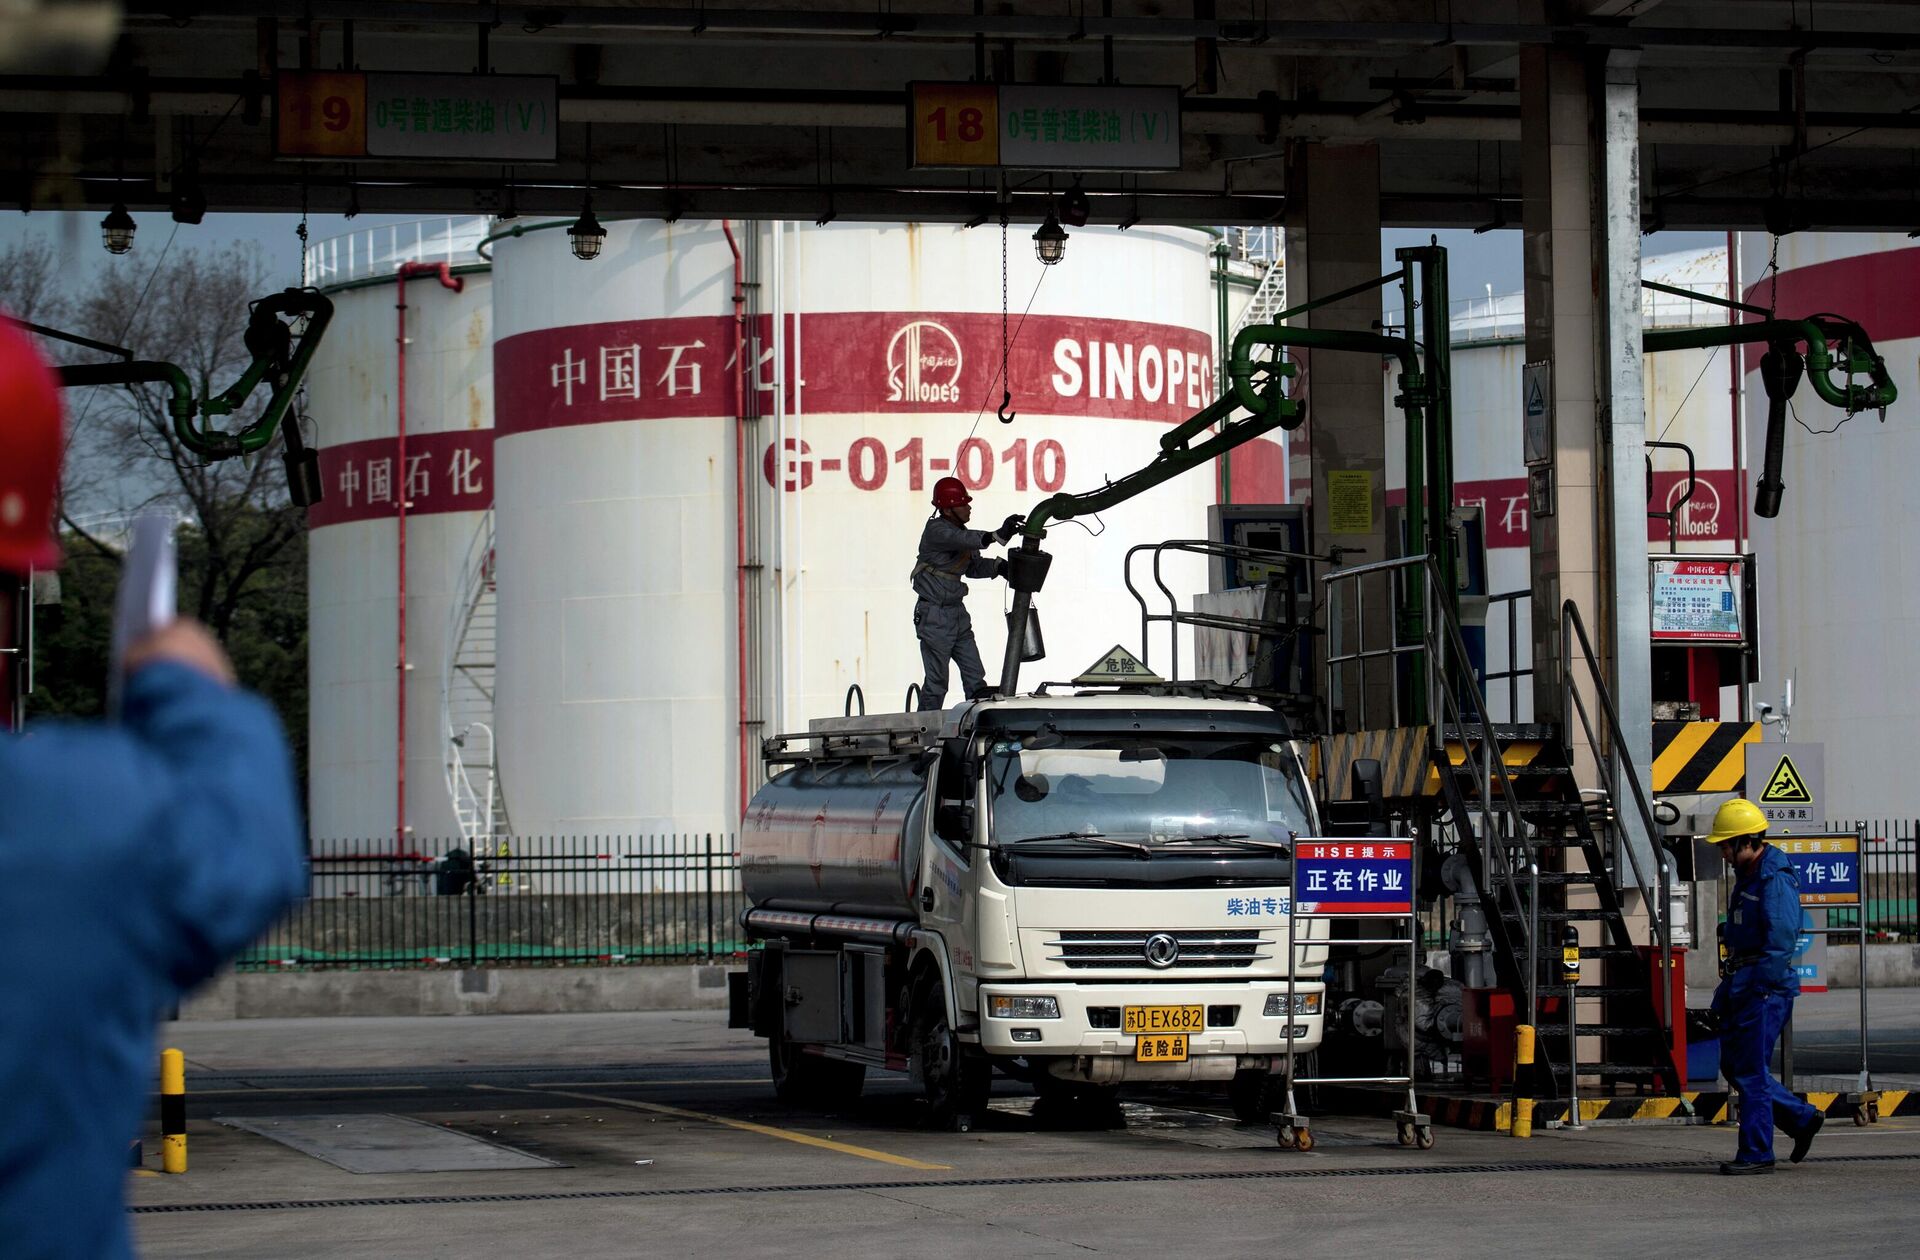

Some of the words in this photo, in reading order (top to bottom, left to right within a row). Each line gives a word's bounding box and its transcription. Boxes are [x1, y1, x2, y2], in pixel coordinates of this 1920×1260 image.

[290, 94, 350, 131] 19
[927, 106, 984, 142] 18
[1051, 338, 1211, 410] SINOPEC
[763, 437, 1067, 492] G-01-010
[339, 448, 483, 507] 中国石化
[1687, 566, 1716, 574] 中国石化
[1105, 658, 1136, 673] 危险
[1766, 809, 1807, 820] 当心滑跌
[1768, 841, 1842, 852] SE提示
[1307, 869, 1403, 892] 正在作业
[1794, 862, 1850, 884] 作业
[1141, 1039, 1184, 1056] 危险品
